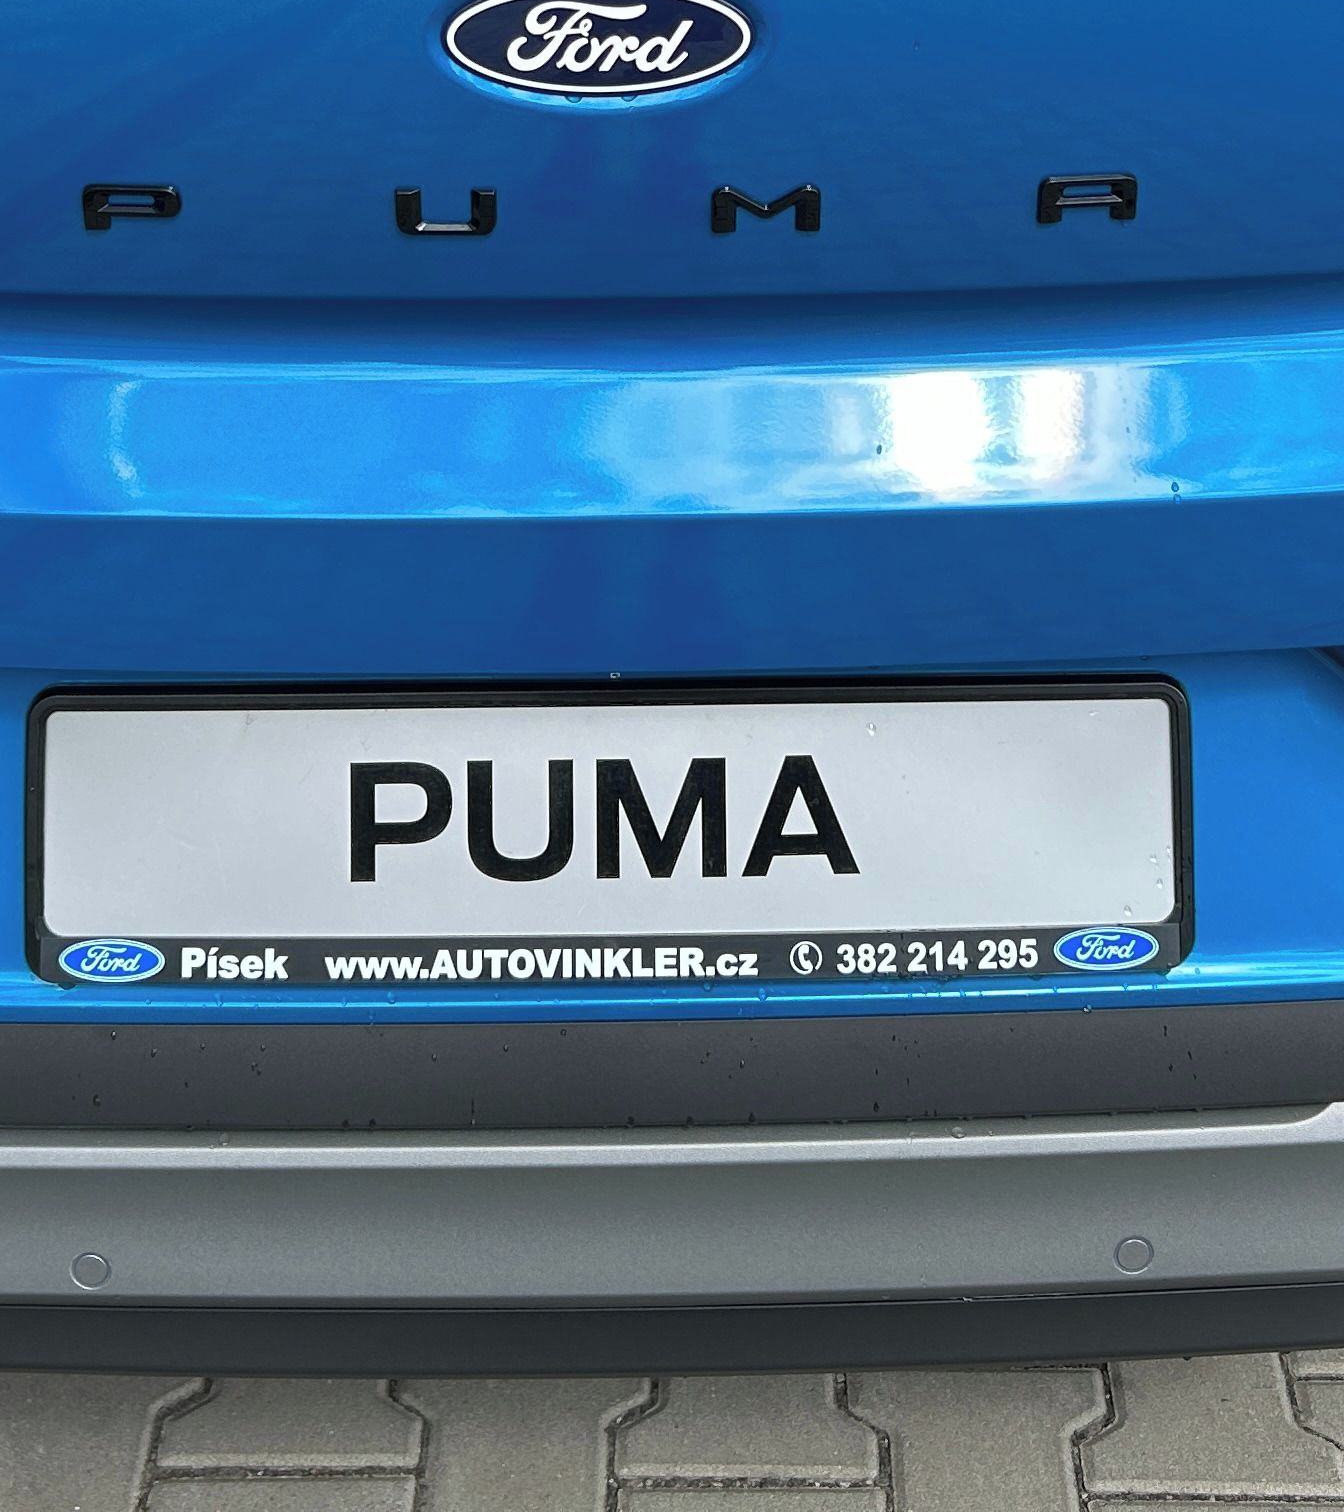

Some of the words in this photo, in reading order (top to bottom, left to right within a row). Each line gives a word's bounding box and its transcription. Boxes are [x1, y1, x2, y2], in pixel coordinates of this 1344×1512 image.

[506, 0, 696, 76] Ford
[80, 171, 1140, 237] PUMA
[349, 754, 862, 884] PUMA
[79, 944, 141, 973] Ford
[181, 946, 290, 980] Písek
[324, 947, 760, 980] www.AUTOVINKLER.cz
[836, 942, 897, 974] 382
[907, 940, 969, 974] 214
[977, 938, 1039, 970] 295
[1074, 934, 1137, 961] Ford
